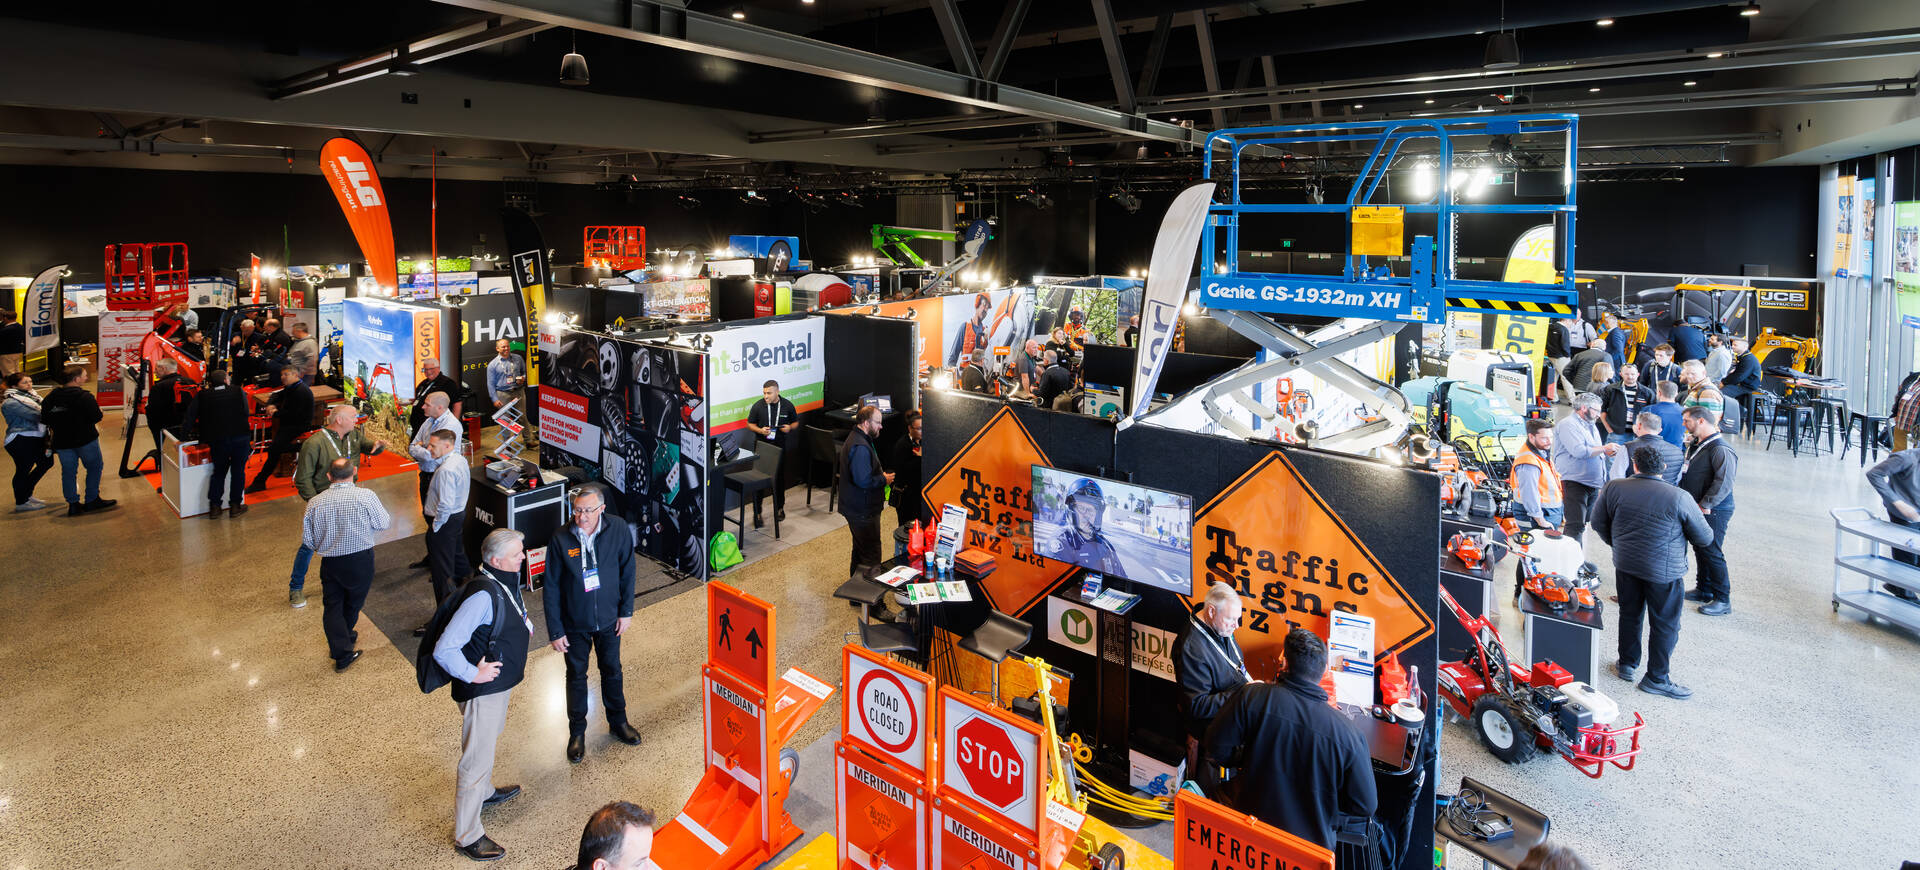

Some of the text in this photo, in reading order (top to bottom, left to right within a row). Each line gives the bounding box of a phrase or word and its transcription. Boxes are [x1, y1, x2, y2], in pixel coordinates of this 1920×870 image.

[328, 160, 357, 209] reachingout
[337, 156, 382, 207] JLG
[1207, 282, 1402, 309] Genie GS-1932m XH
[1760, 291, 1805, 302] JCB
[741, 332, 812, 371] Rental
[541, 393, 556, 404] KEEPS
[557, 398, 567, 407] YOU
[541, 415, 583, 435] PARTS FOR MOBILE
[565, 430, 579, 441] WORK
[969, 528, 1002, 554] NZ
[1011, 540, 1046, 568] Ltd
[1206, 525, 1369, 595] Traffic
[715, 683, 754, 714] MERIDIAN
[874, 689, 899, 713] ROAD
[869, 707, 905, 736] CLOSED
[960, 736, 1021, 785] STOP
[854, 765, 906, 805] MERIDIAN
[951, 819, 1016, 868] MERIDIAN
[1187, 818, 1302, 870] EMERGEN
